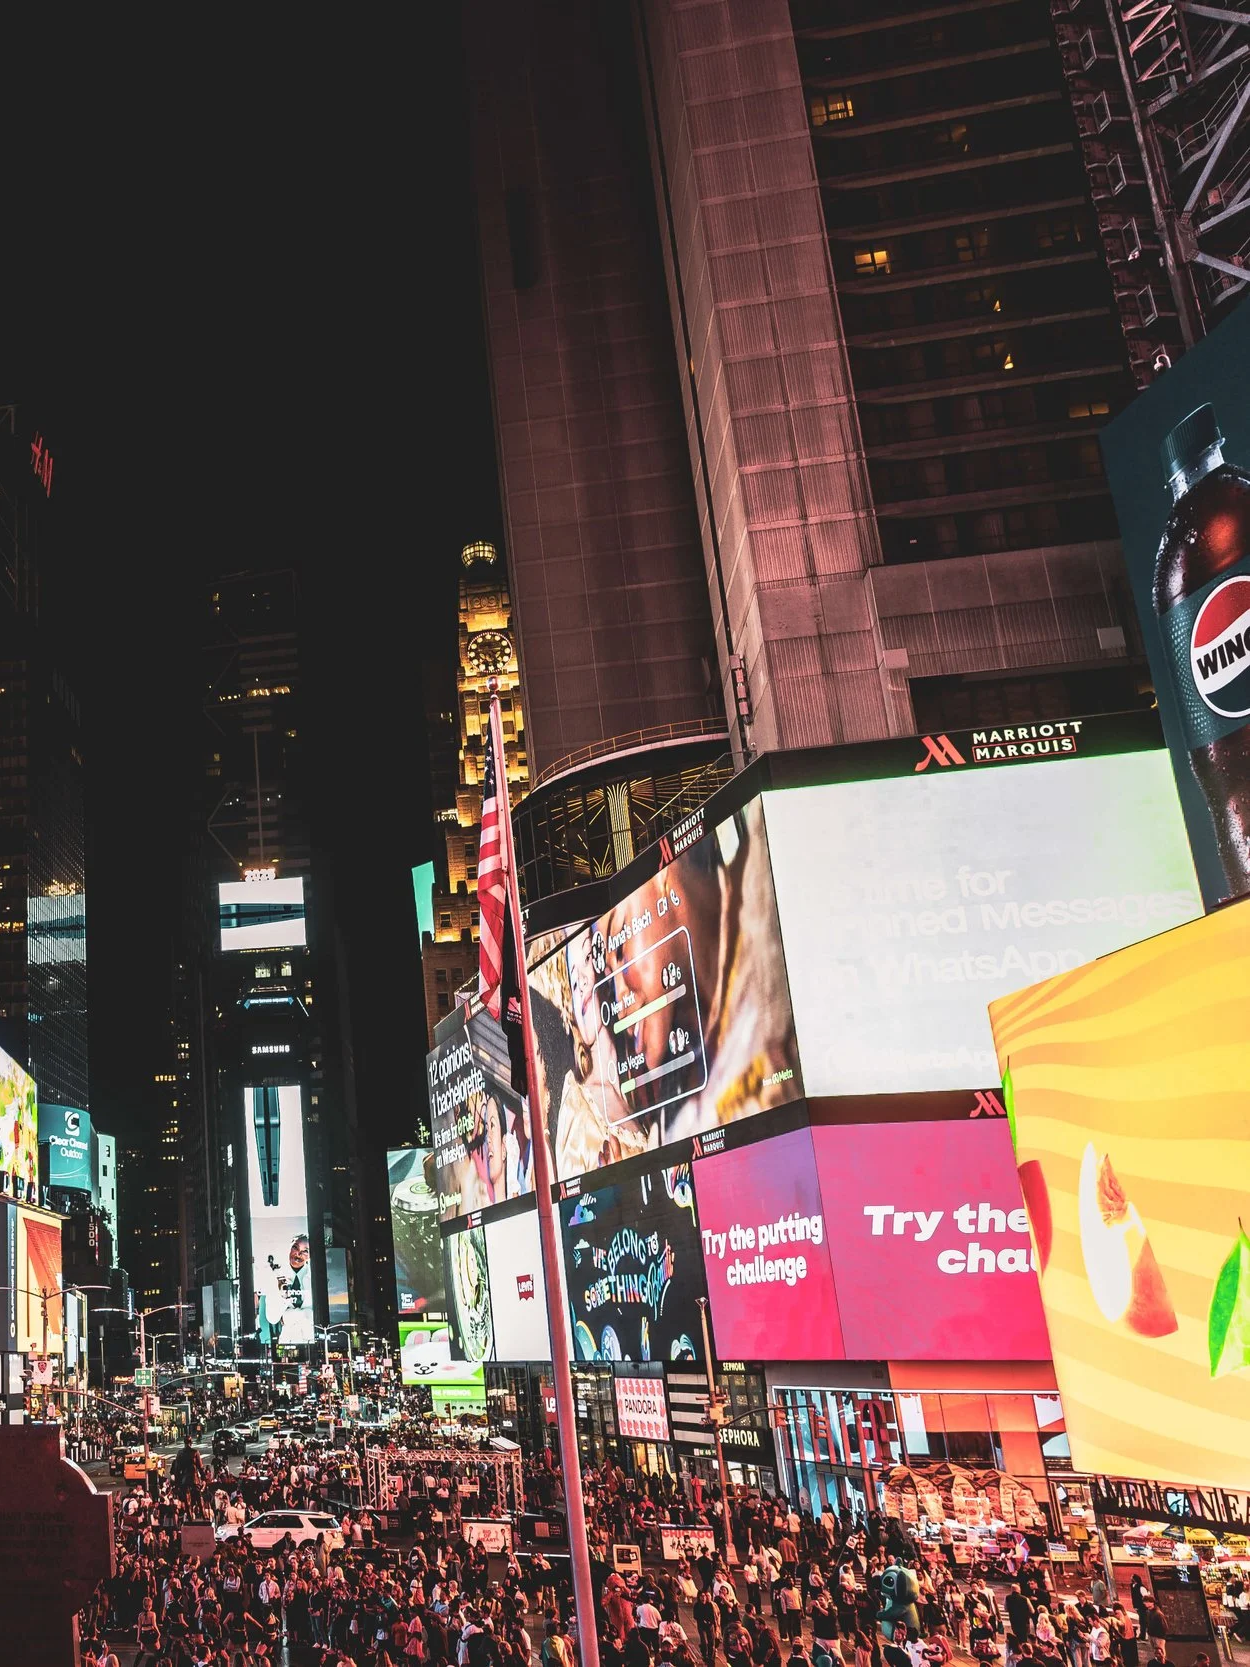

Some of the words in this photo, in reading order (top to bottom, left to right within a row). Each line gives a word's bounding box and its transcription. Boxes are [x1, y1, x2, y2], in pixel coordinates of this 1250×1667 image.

[30, 430, 54, 498] H&M
[972, 720, 1083, 745] MARRIOTT
[974, 737, 1074, 760] MARQUIS
[673, 808, 705, 841] MARRIOTT
[674, 825, 703, 854] MARQUIS
[955, 865, 1014, 898] for
[979, 888, 1200, 929] Messages
[608, 924, 632, 953] Anna's
[632, 908, 652, 935] Bach
[676, 966, 681, 980] 6
[252, 1044, 290, 1054] SAMSUNG
[684, 1031, 690, 1045] 2
[428, 1059, 439, 1087] 12
[627, 1052, 645, 1072] Vegas
[702, 1229, 726, 1259] Try
[729, 1223, 755, 1251] the
[758, 1212, 823, 1253] putting
[863, 1205, 944, 1241] Try
[952, 1202, 1028, 1234] the
[607, 1228, 647, 1276] BELONG
[726, 1255, 807, 1287] challenge
[723, 1362, 746, 1371] SEPHORA
[624, 1398, 658, 1415] PANDORA
[718, 1428, 760, 1447] SEPHORA
[662, 1528, 713, 1539] CHICAGO
